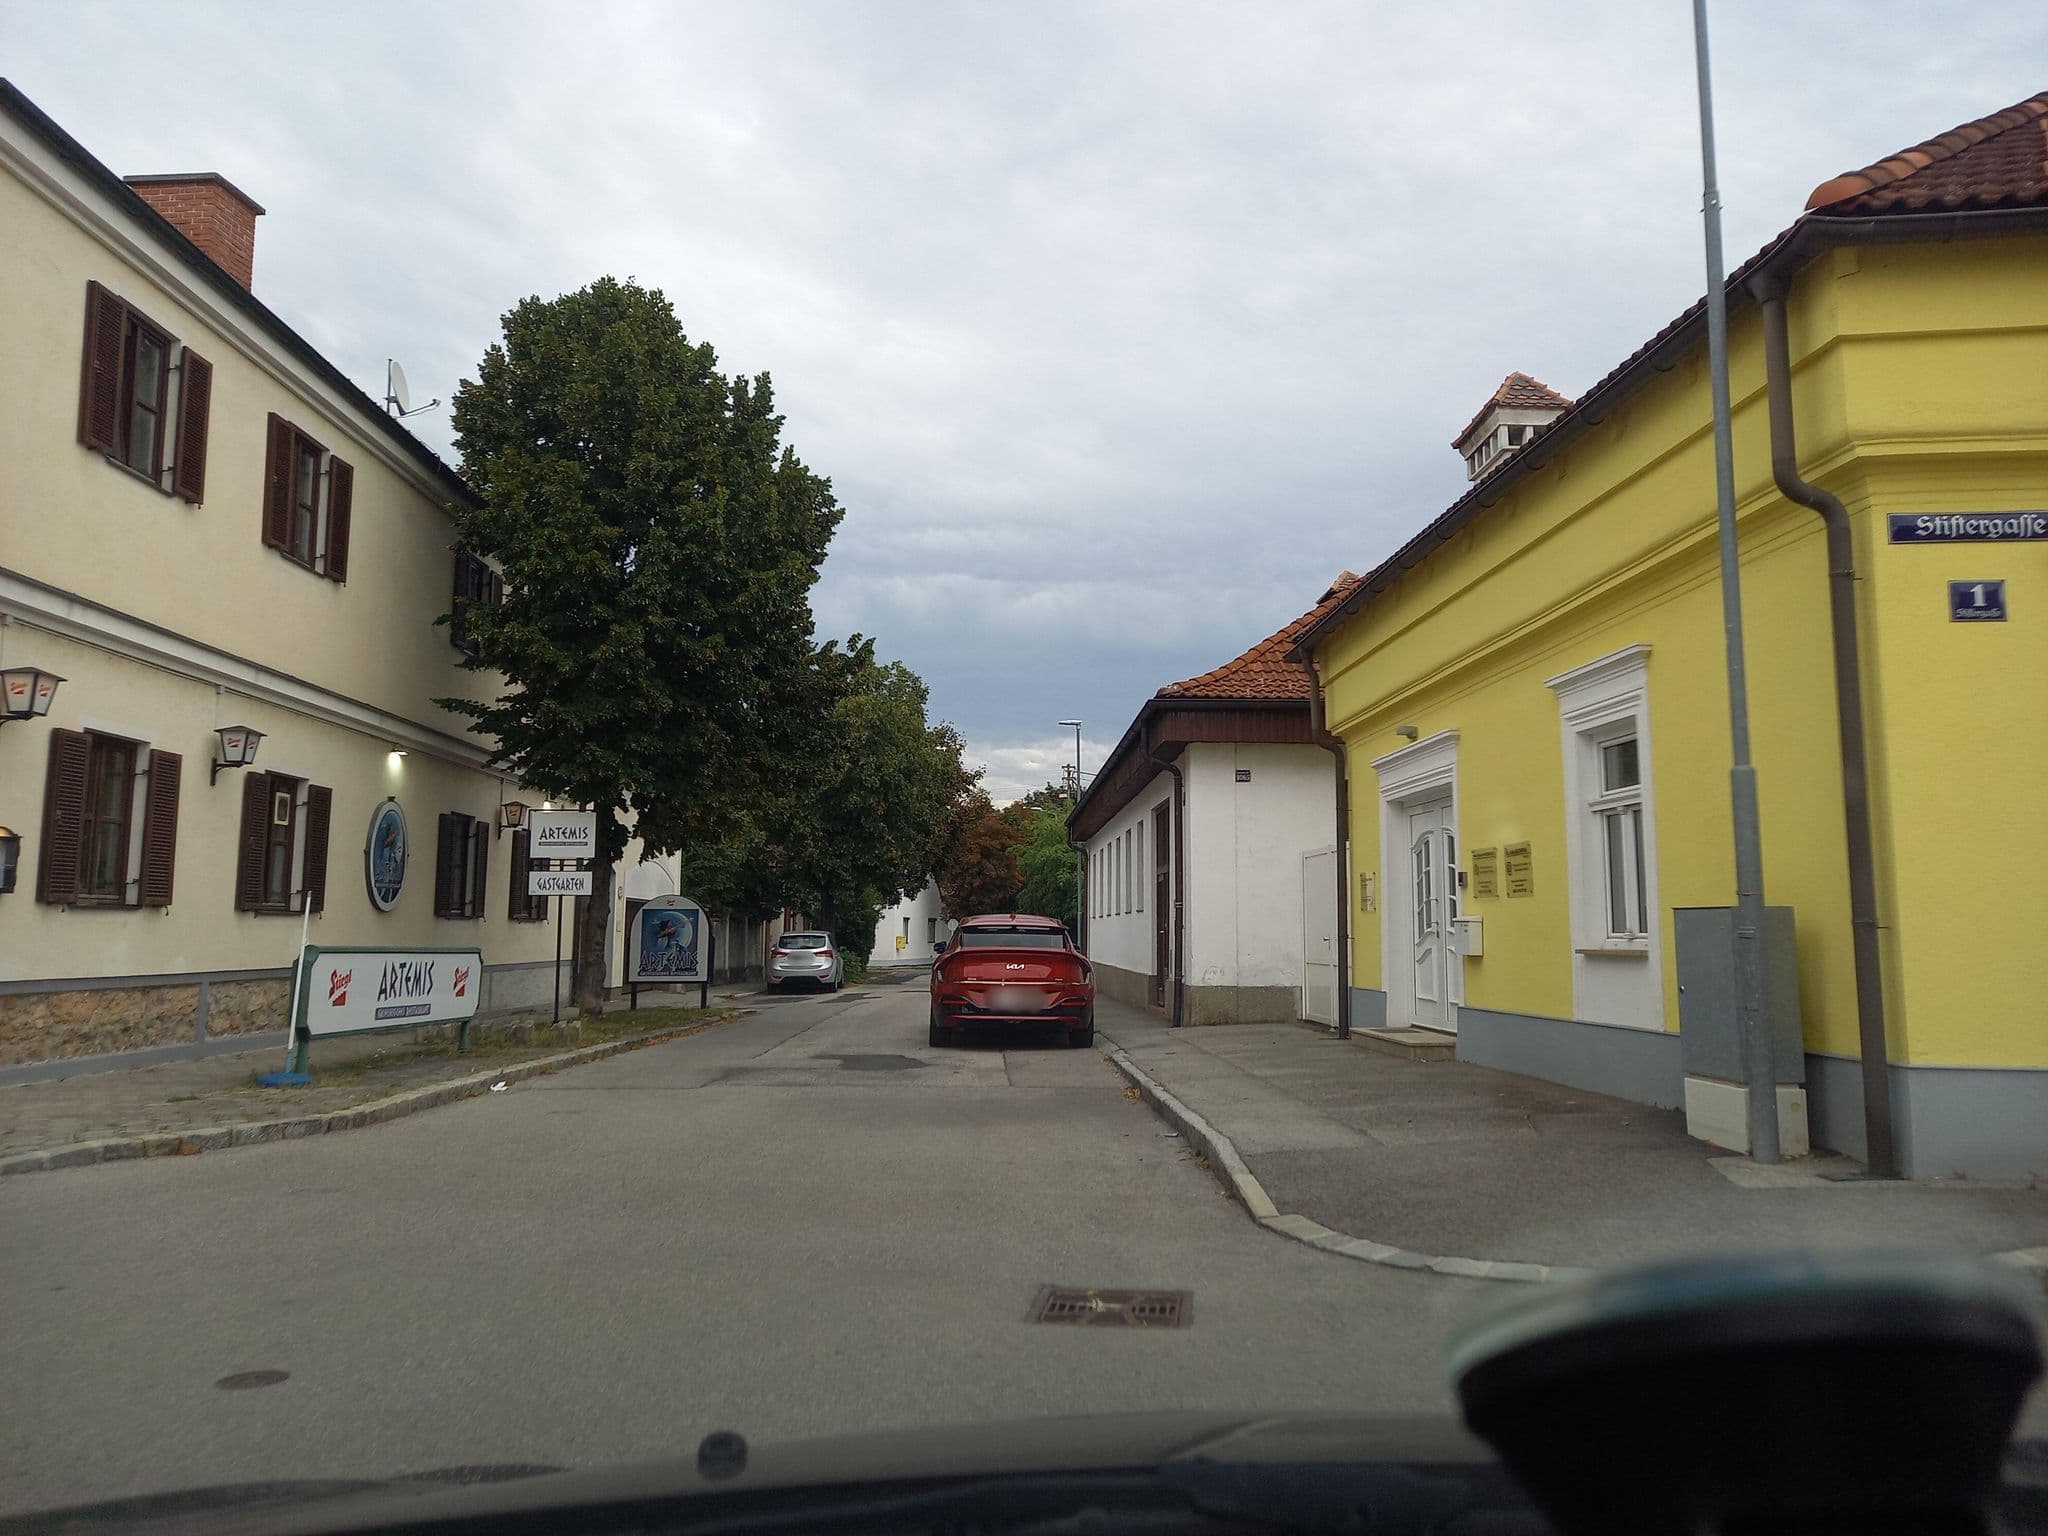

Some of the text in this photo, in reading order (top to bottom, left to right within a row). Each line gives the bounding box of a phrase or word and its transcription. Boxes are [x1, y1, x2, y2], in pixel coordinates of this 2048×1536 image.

[1970, 584, 1988, 607] 1
[540, 827, 588, 840] ARTEMIS
[537, 877, 585, 891] GASTGARTEN
[639, 950, 699, 971] ARTEMIS
[328, 968, 352, 1000] Stiegl
[377, 960, 435, 1002] ARTEMIS
